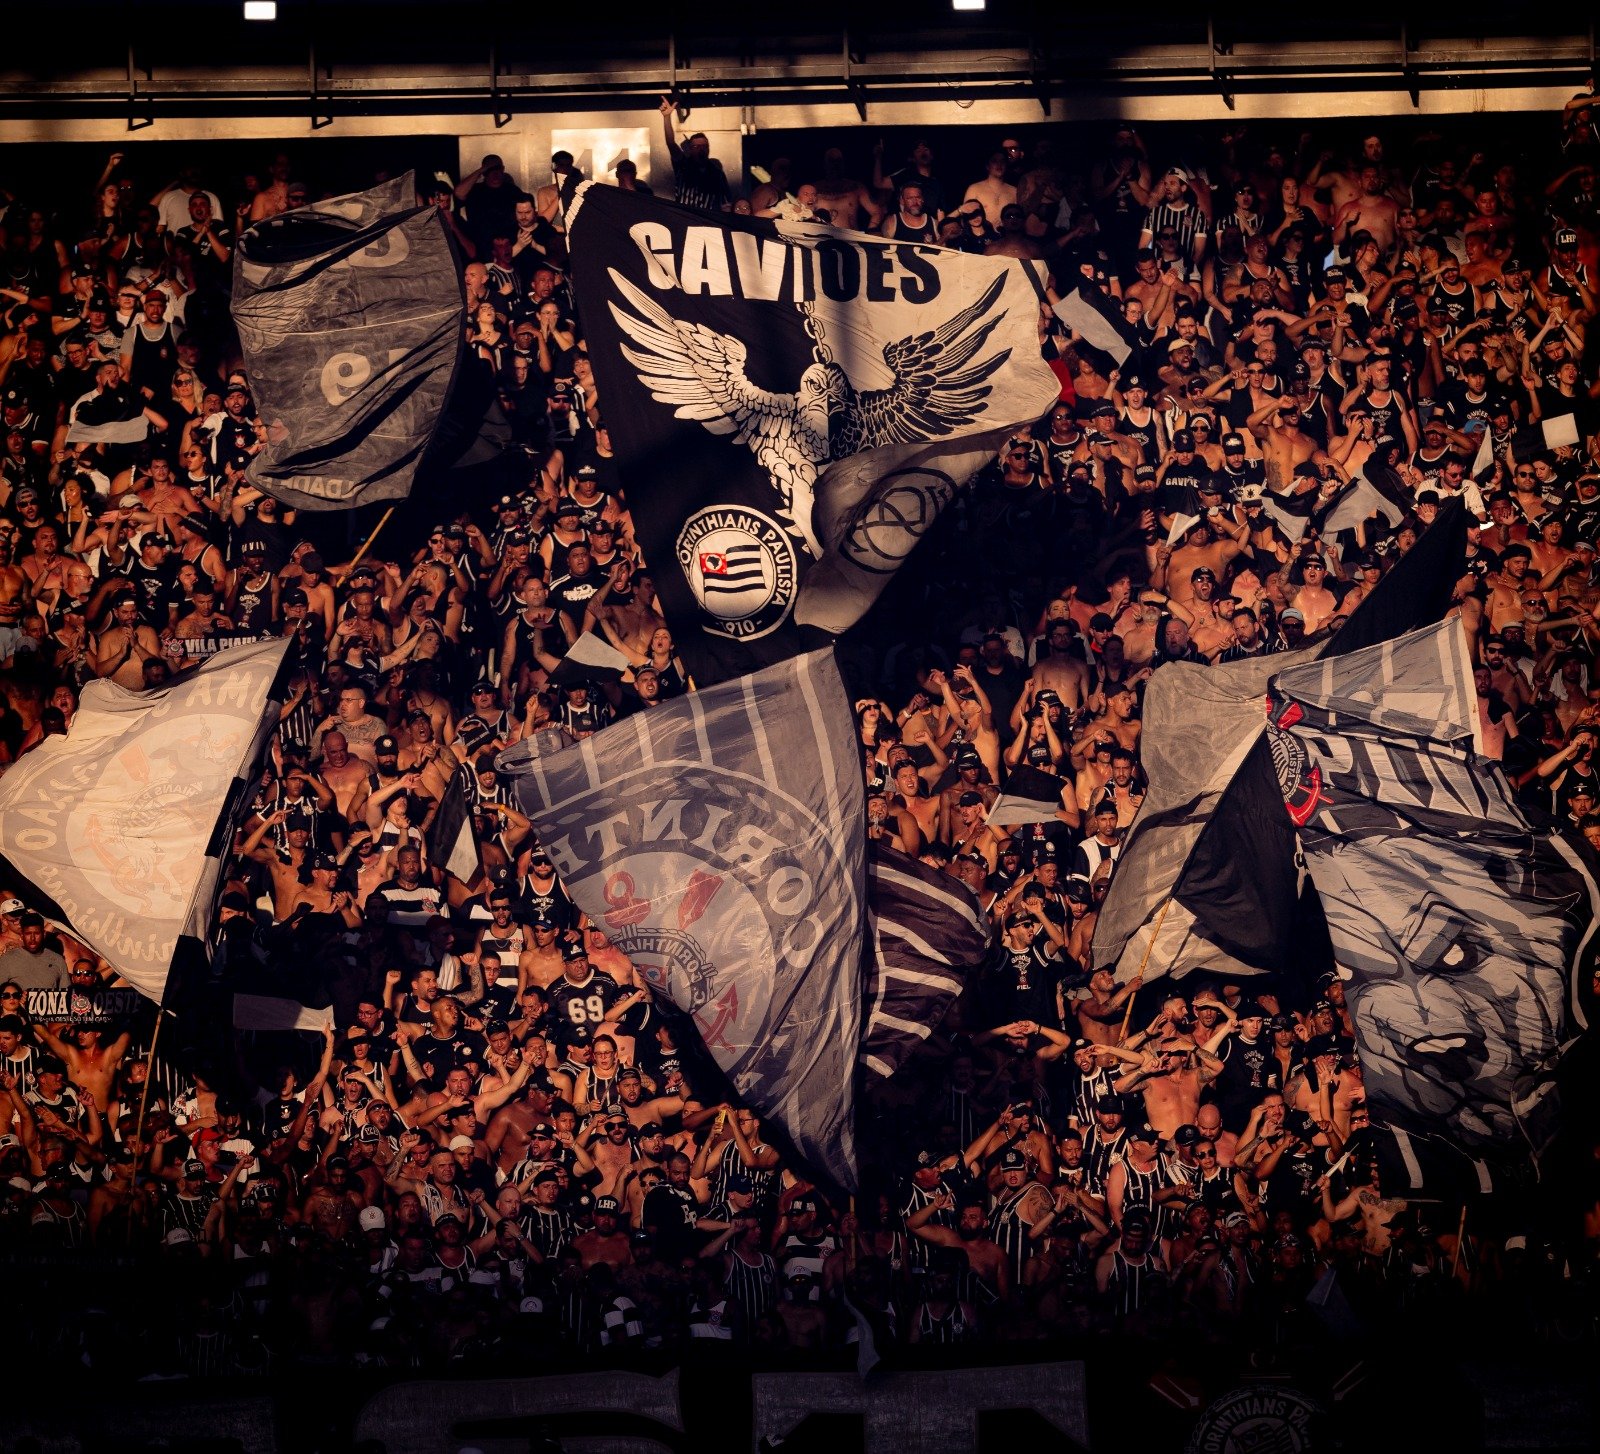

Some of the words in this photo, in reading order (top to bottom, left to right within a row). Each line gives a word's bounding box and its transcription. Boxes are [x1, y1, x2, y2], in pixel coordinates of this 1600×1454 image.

[1560, 233, 1577, 244] LHP
[680, 513, 762, 565] ORINTHIANS
[762, 529, 793, 606] PAULISTA
[184, 638, 217, 653] VILA
[1279, 732, 1297, 779] PAULISTA
[869, 777, 884, 787] HP
[28, 990, 69, 1016] ZONA
[567, 995, 604, 1023] 69
[598, 1199, 617, 1209] LHP
[1204, 1397, 1288, 1454] ORINTHIANS
